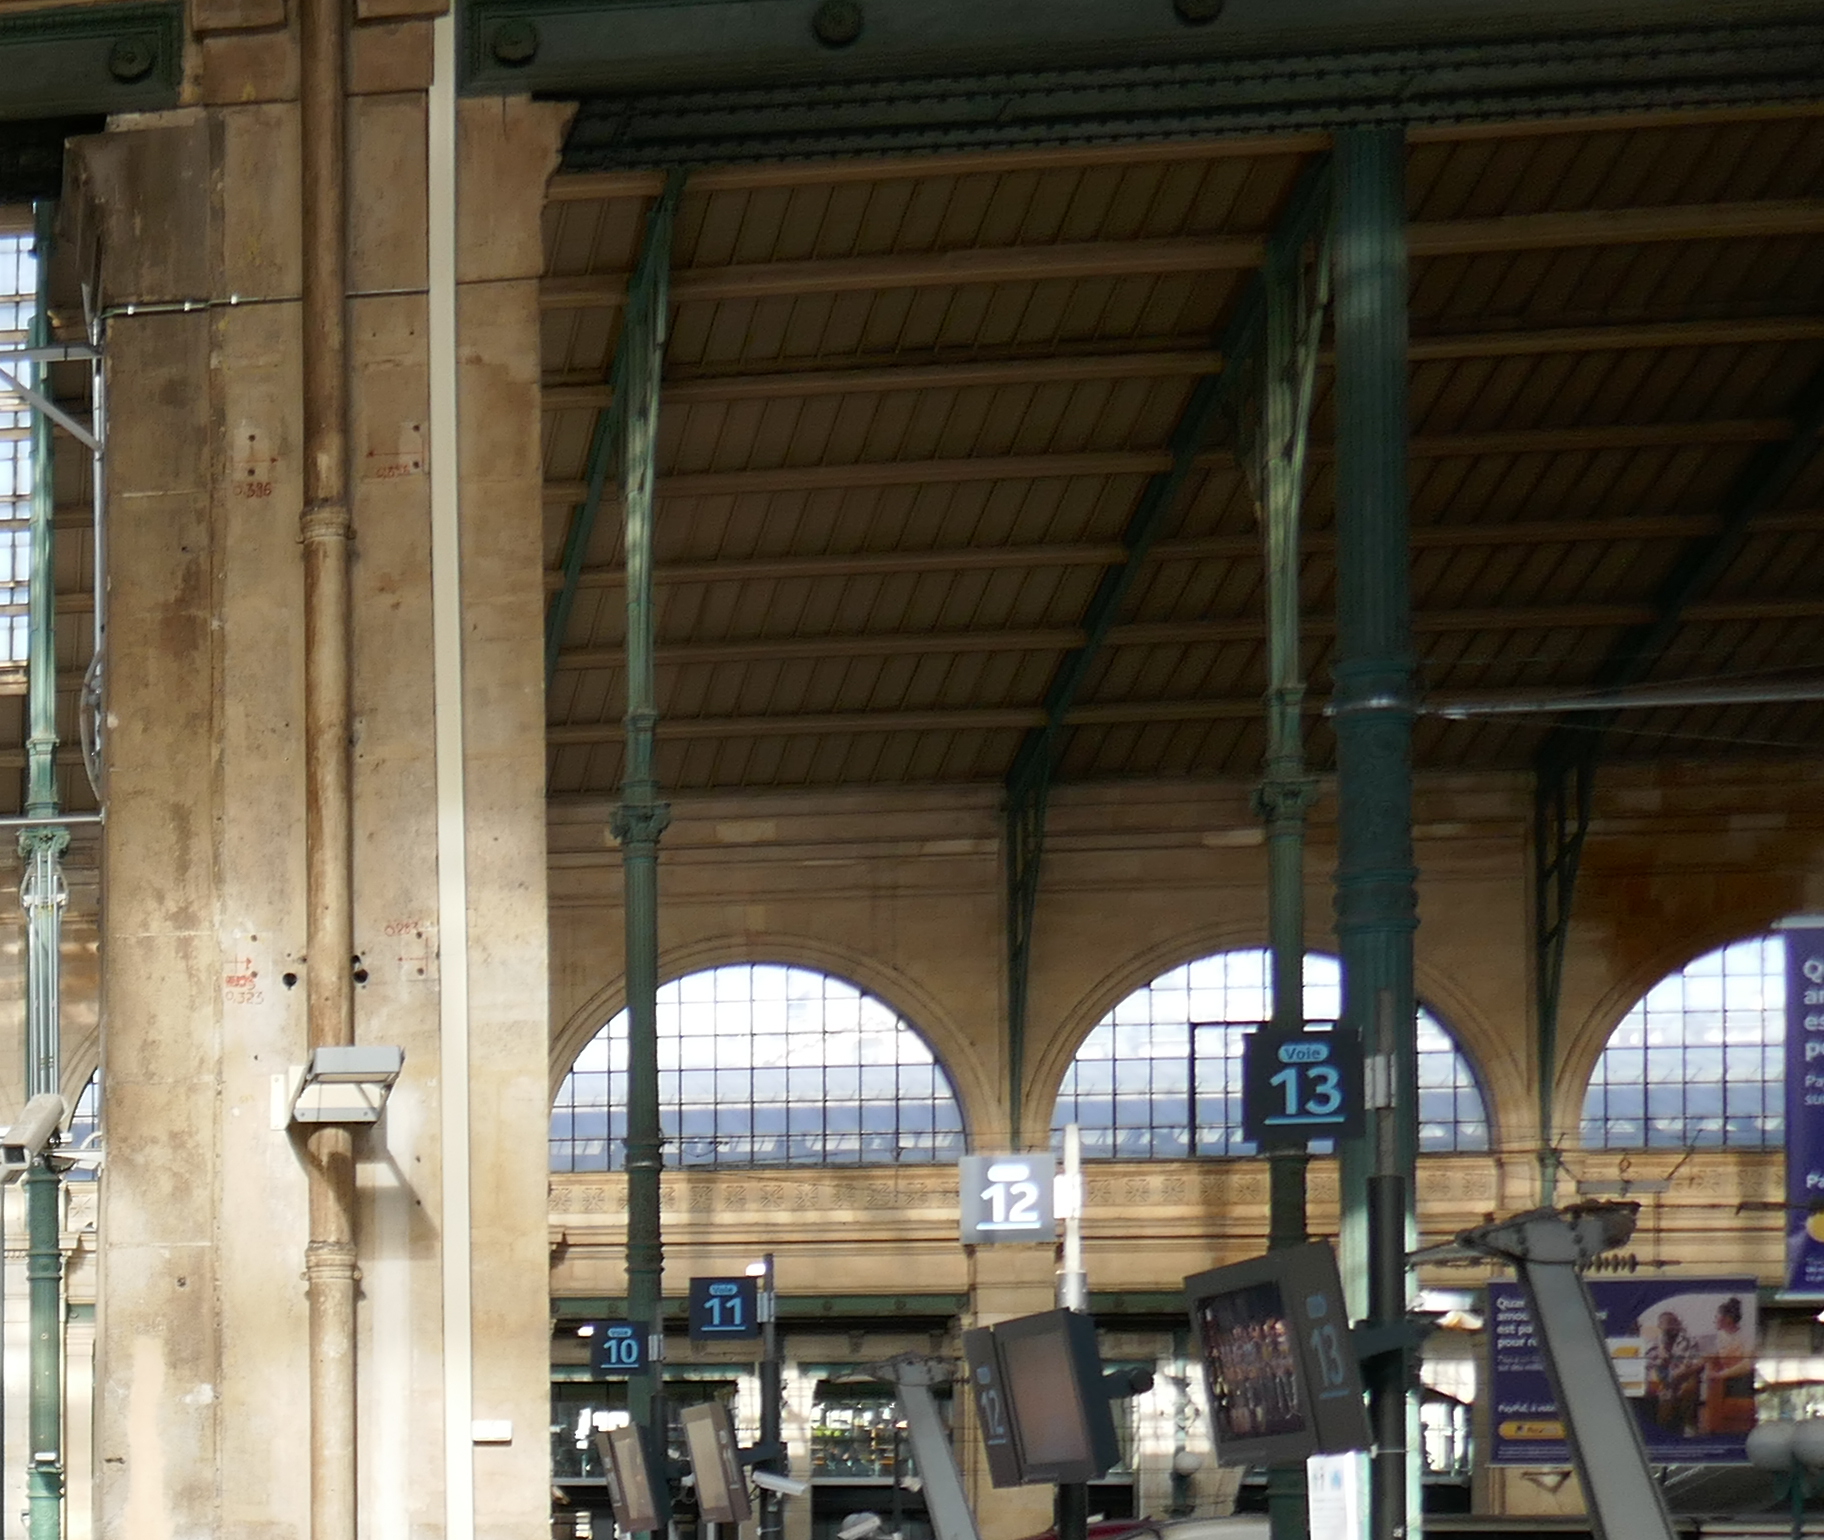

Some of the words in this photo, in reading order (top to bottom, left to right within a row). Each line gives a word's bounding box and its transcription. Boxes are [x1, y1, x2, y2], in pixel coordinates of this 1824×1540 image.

[1283, 1047, 1321, 1060] Voie
[1269, 1066, 1342, 1115] 13
[980, 1182, 1038, 1223] 12
[703, 1297, 743, 1325] 11
[603, 1339, 639, 1363] 10
